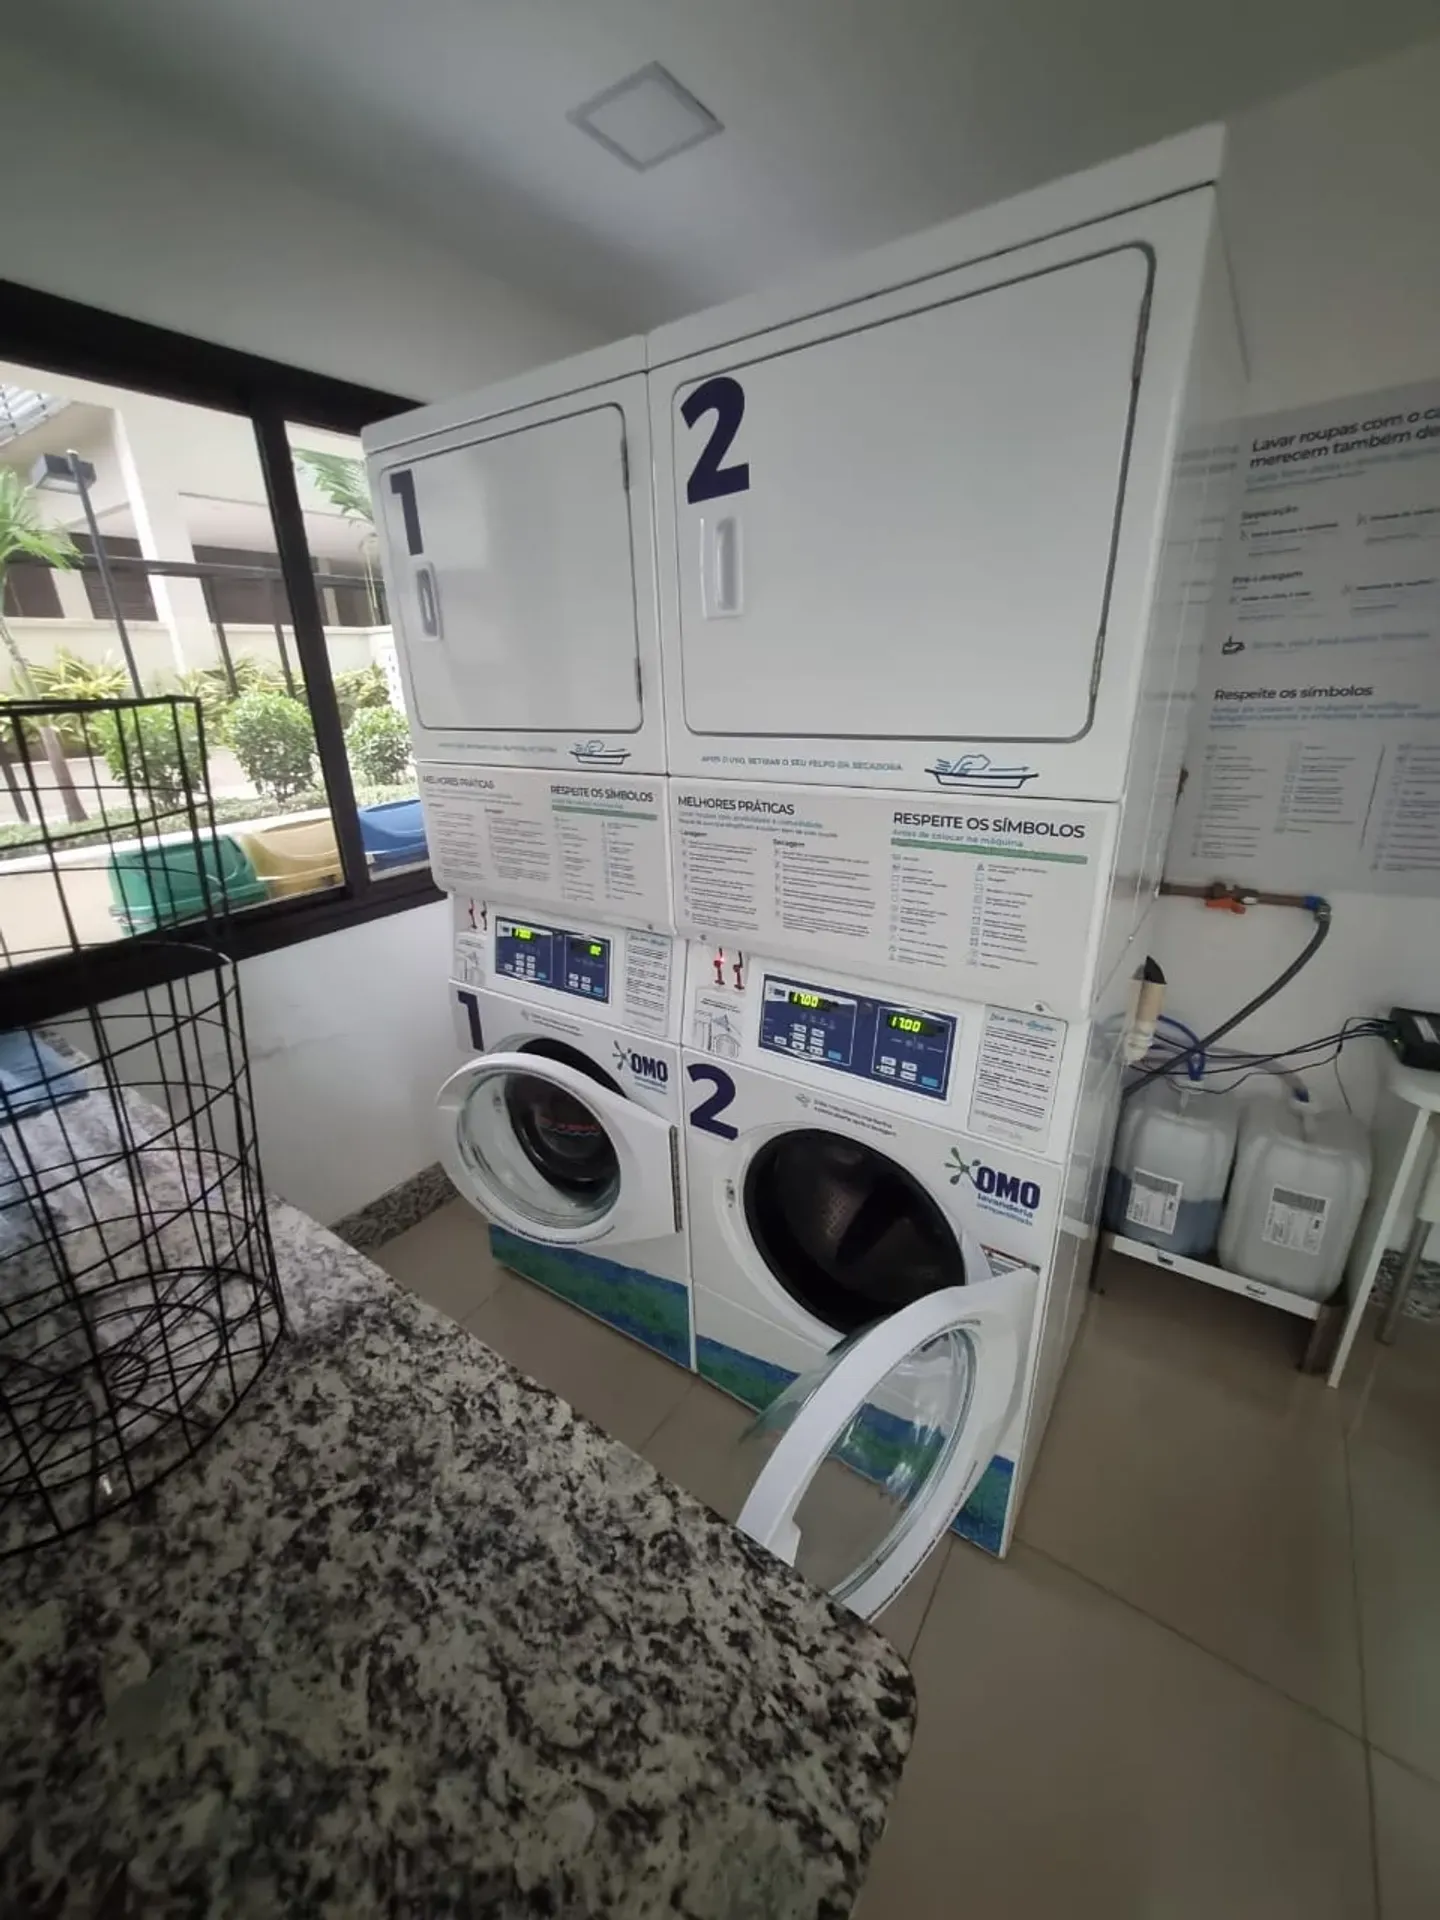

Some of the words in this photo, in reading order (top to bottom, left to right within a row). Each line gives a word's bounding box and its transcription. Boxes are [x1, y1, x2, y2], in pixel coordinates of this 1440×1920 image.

[681, 376, 750, 504] 2
[1250, 446, 1328, 469] merecem
[1332, 429, 1411, 454] também
[1252, 434, 1297, 452] Lavar
[1299, 421, 1359, 443] roupas
[1361, 414, 1402, 431] com
[1407, 411, 1420, 423] o
[390, 469, 424, 556] 1
[1215, 688, 1276, 702] Respeite
[1279, 688, 1297, 699] os
[1300, 684, 1374, 699] símbolos
[790, 759, 807, 768] SEU
[550, 785, 589, 798] RESPEITE
[591, 789, 604, 799] OS
[605, 788, 654, 803] SÍMBOLOS
[678, 796, 736, 811] MELHORES
[738, 799, 795, 816] PRÁTICAS
[893, 812, 963, 830] RESPEITE
[966, 817, 990, 831] OS
[992, 817, 1086, 839] SÍMBOLOS
[457, 990, 484, 1052] 1
[631, 1053, 668, 1083] OMO
[687, 1063, 738, 1141] 2
[977, 1166, 1040, 1210] OMO
